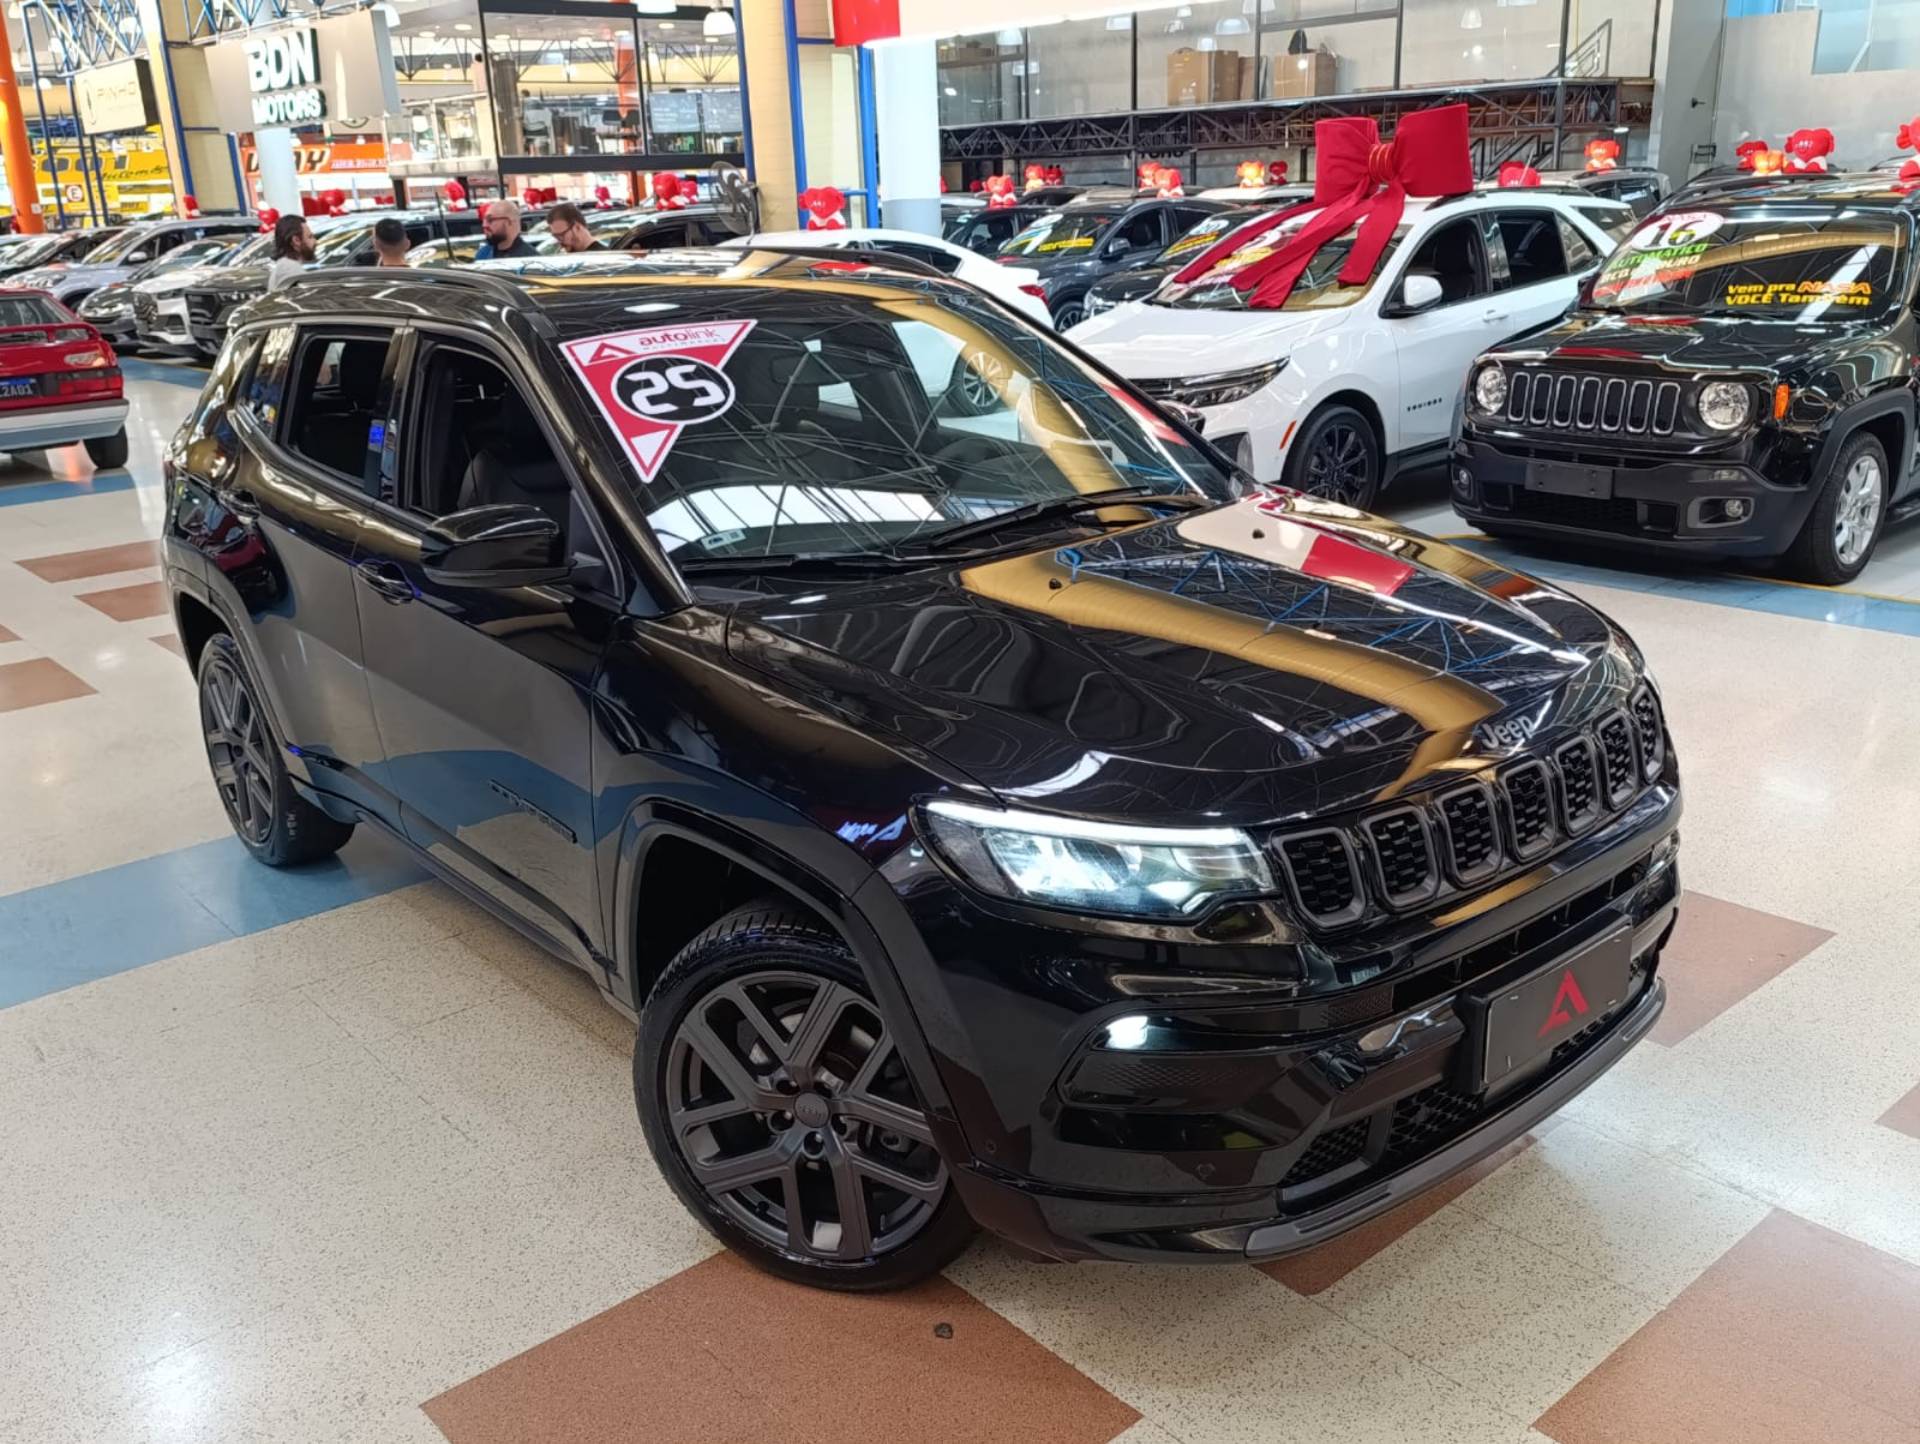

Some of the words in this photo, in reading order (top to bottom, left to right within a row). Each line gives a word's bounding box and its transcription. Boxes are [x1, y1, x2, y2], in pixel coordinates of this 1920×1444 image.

[244, 29, 318, 92] BDN
[252, 88, 324, 124] MOTORS
[1644, 219, 1704, 248] 16
[639, 327, 721, 347] autolink
[624, 364, 726, 415] 25
[1481, 715, 1535, 749] Jeep
